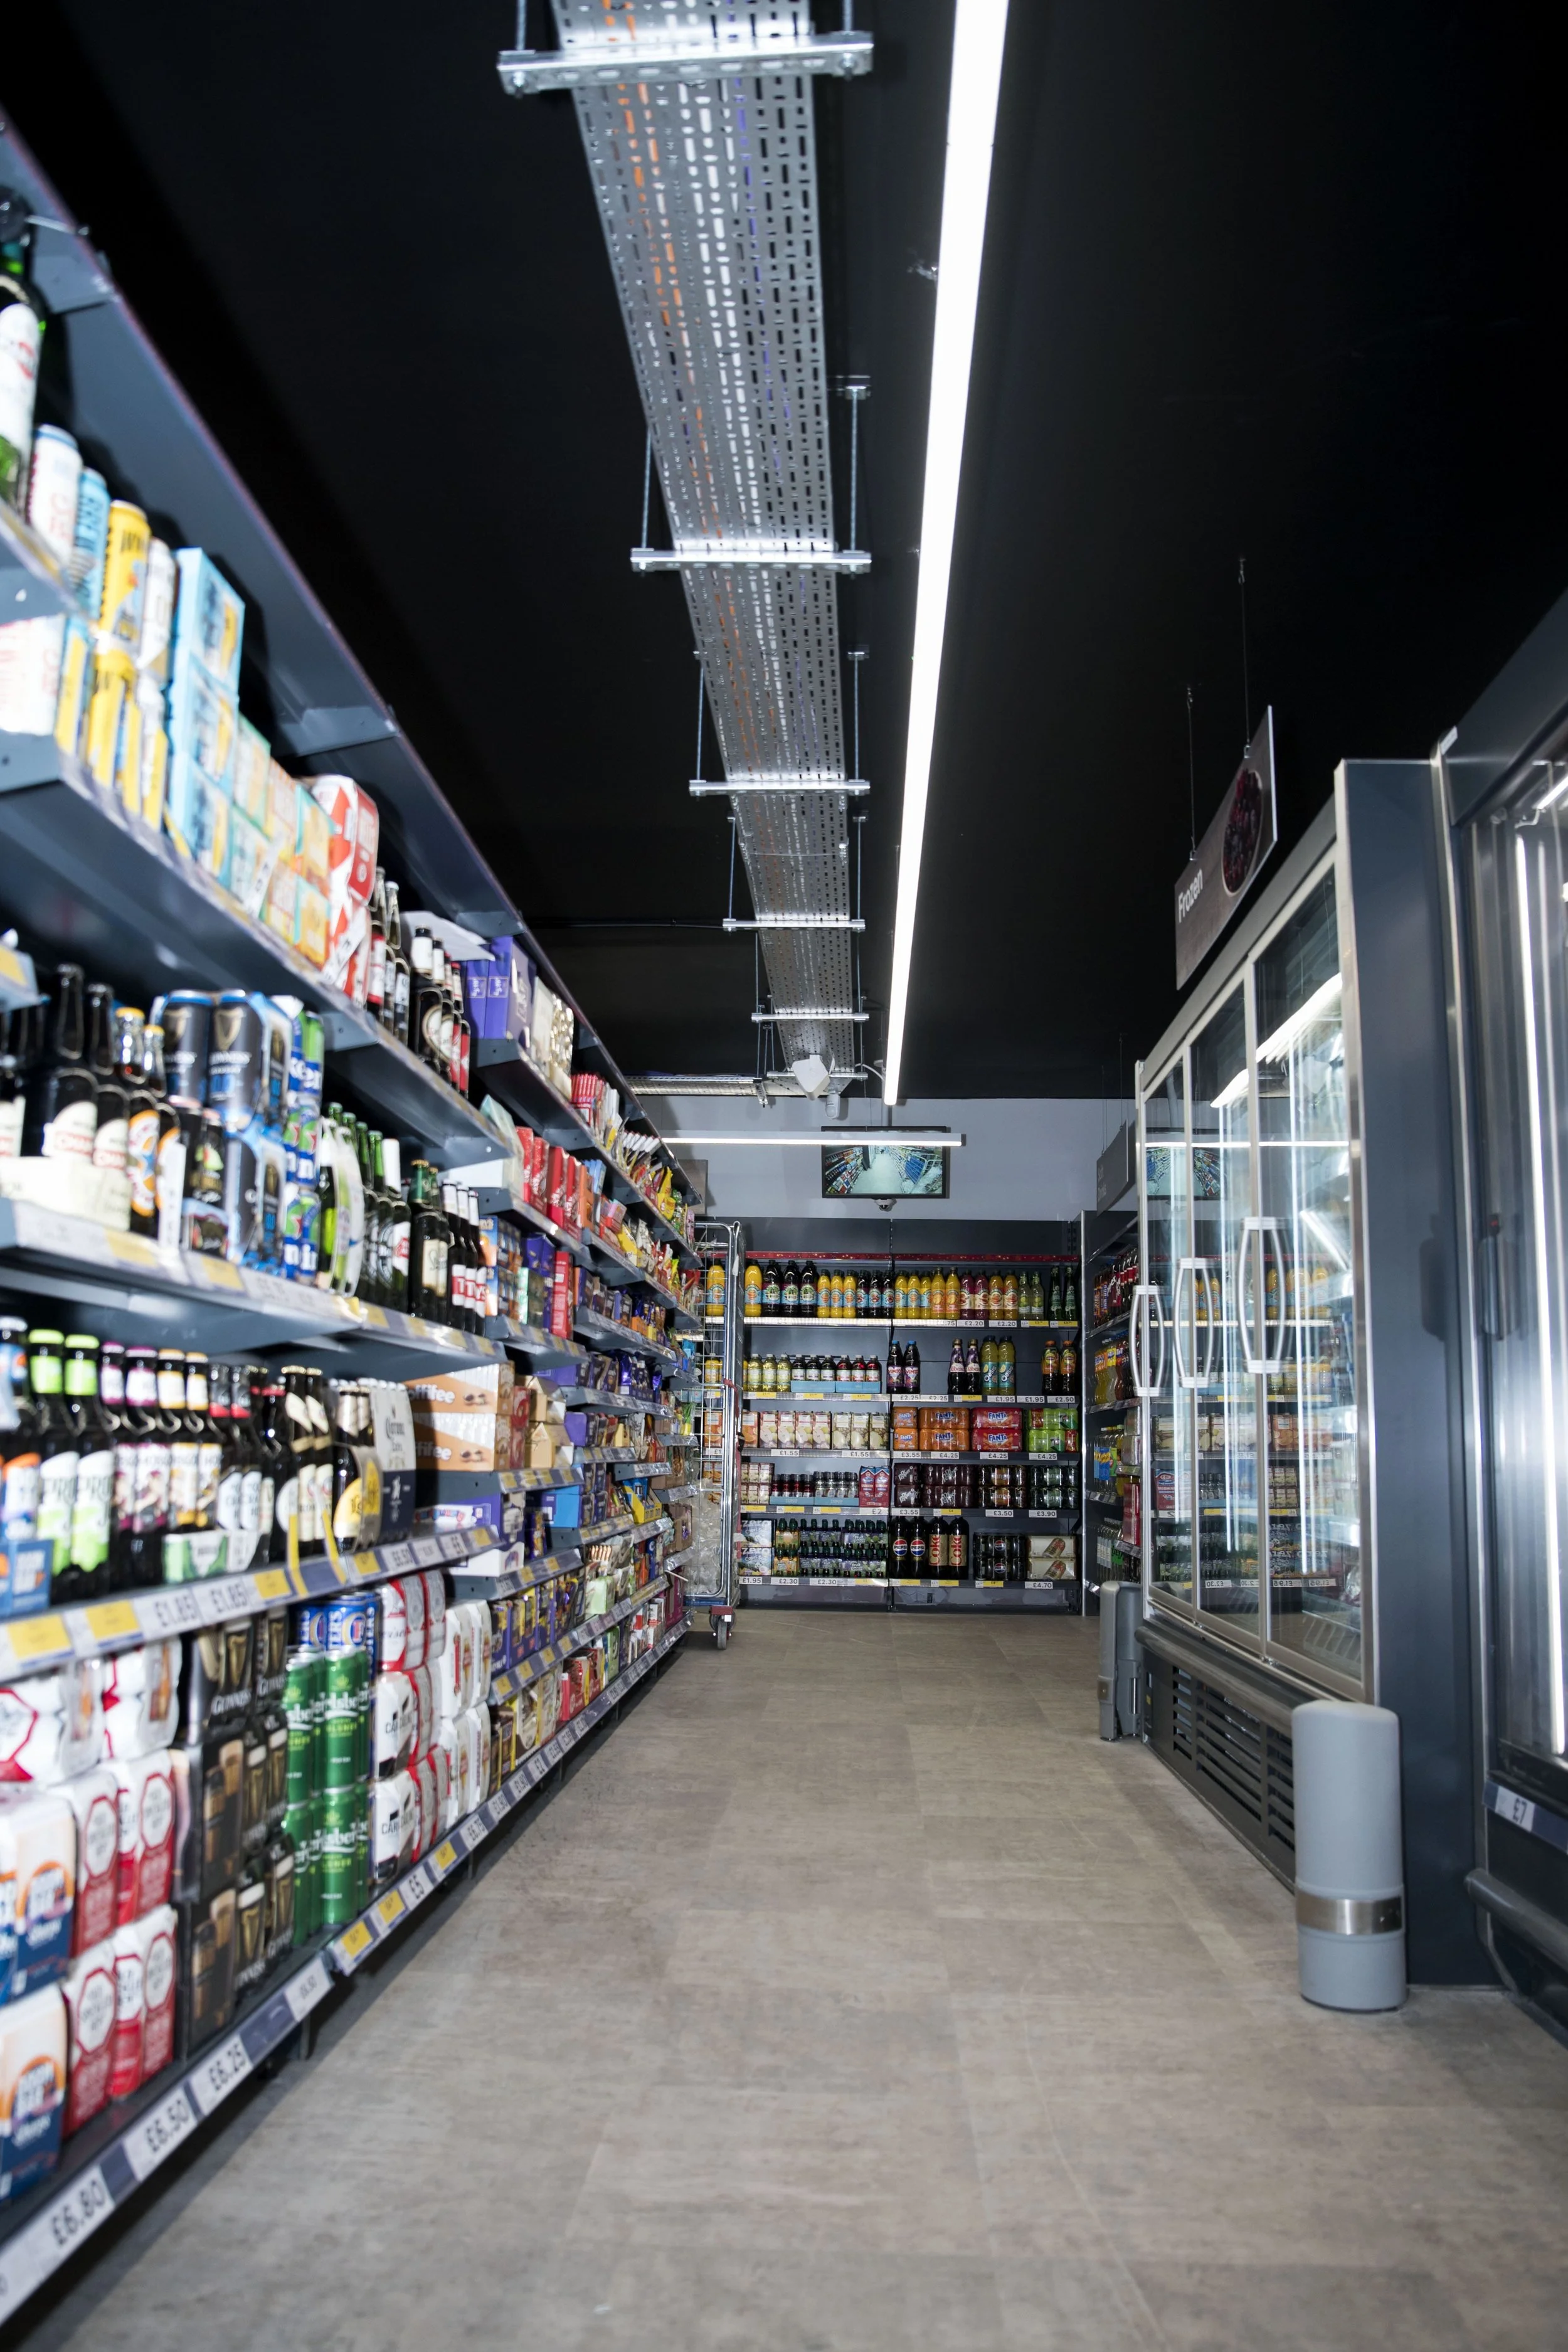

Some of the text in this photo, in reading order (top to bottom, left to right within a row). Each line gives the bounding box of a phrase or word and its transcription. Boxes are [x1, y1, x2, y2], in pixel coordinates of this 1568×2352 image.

[1179, 869, 1203, 923] Frozen
[984, 1366, 997, 1382] Oasis
[1001, 1366, 1014, 1382] Oasis
[988, 1411, 1008, 1420] FANTA
[988, 1433, 1008, 1442] FANTA
[930, 1535, 940, 1565] Coke
[951, 1535, 962, 1565] Coke
[1512, 1798, 1528, 1825] £7
[409, 1874, 425, 1900] £5
[209, 2043, 246, 2092] £6.25
[146, 2098, 188, 2153] £6.50
[50, 2180, 106, 2247] £6.80
